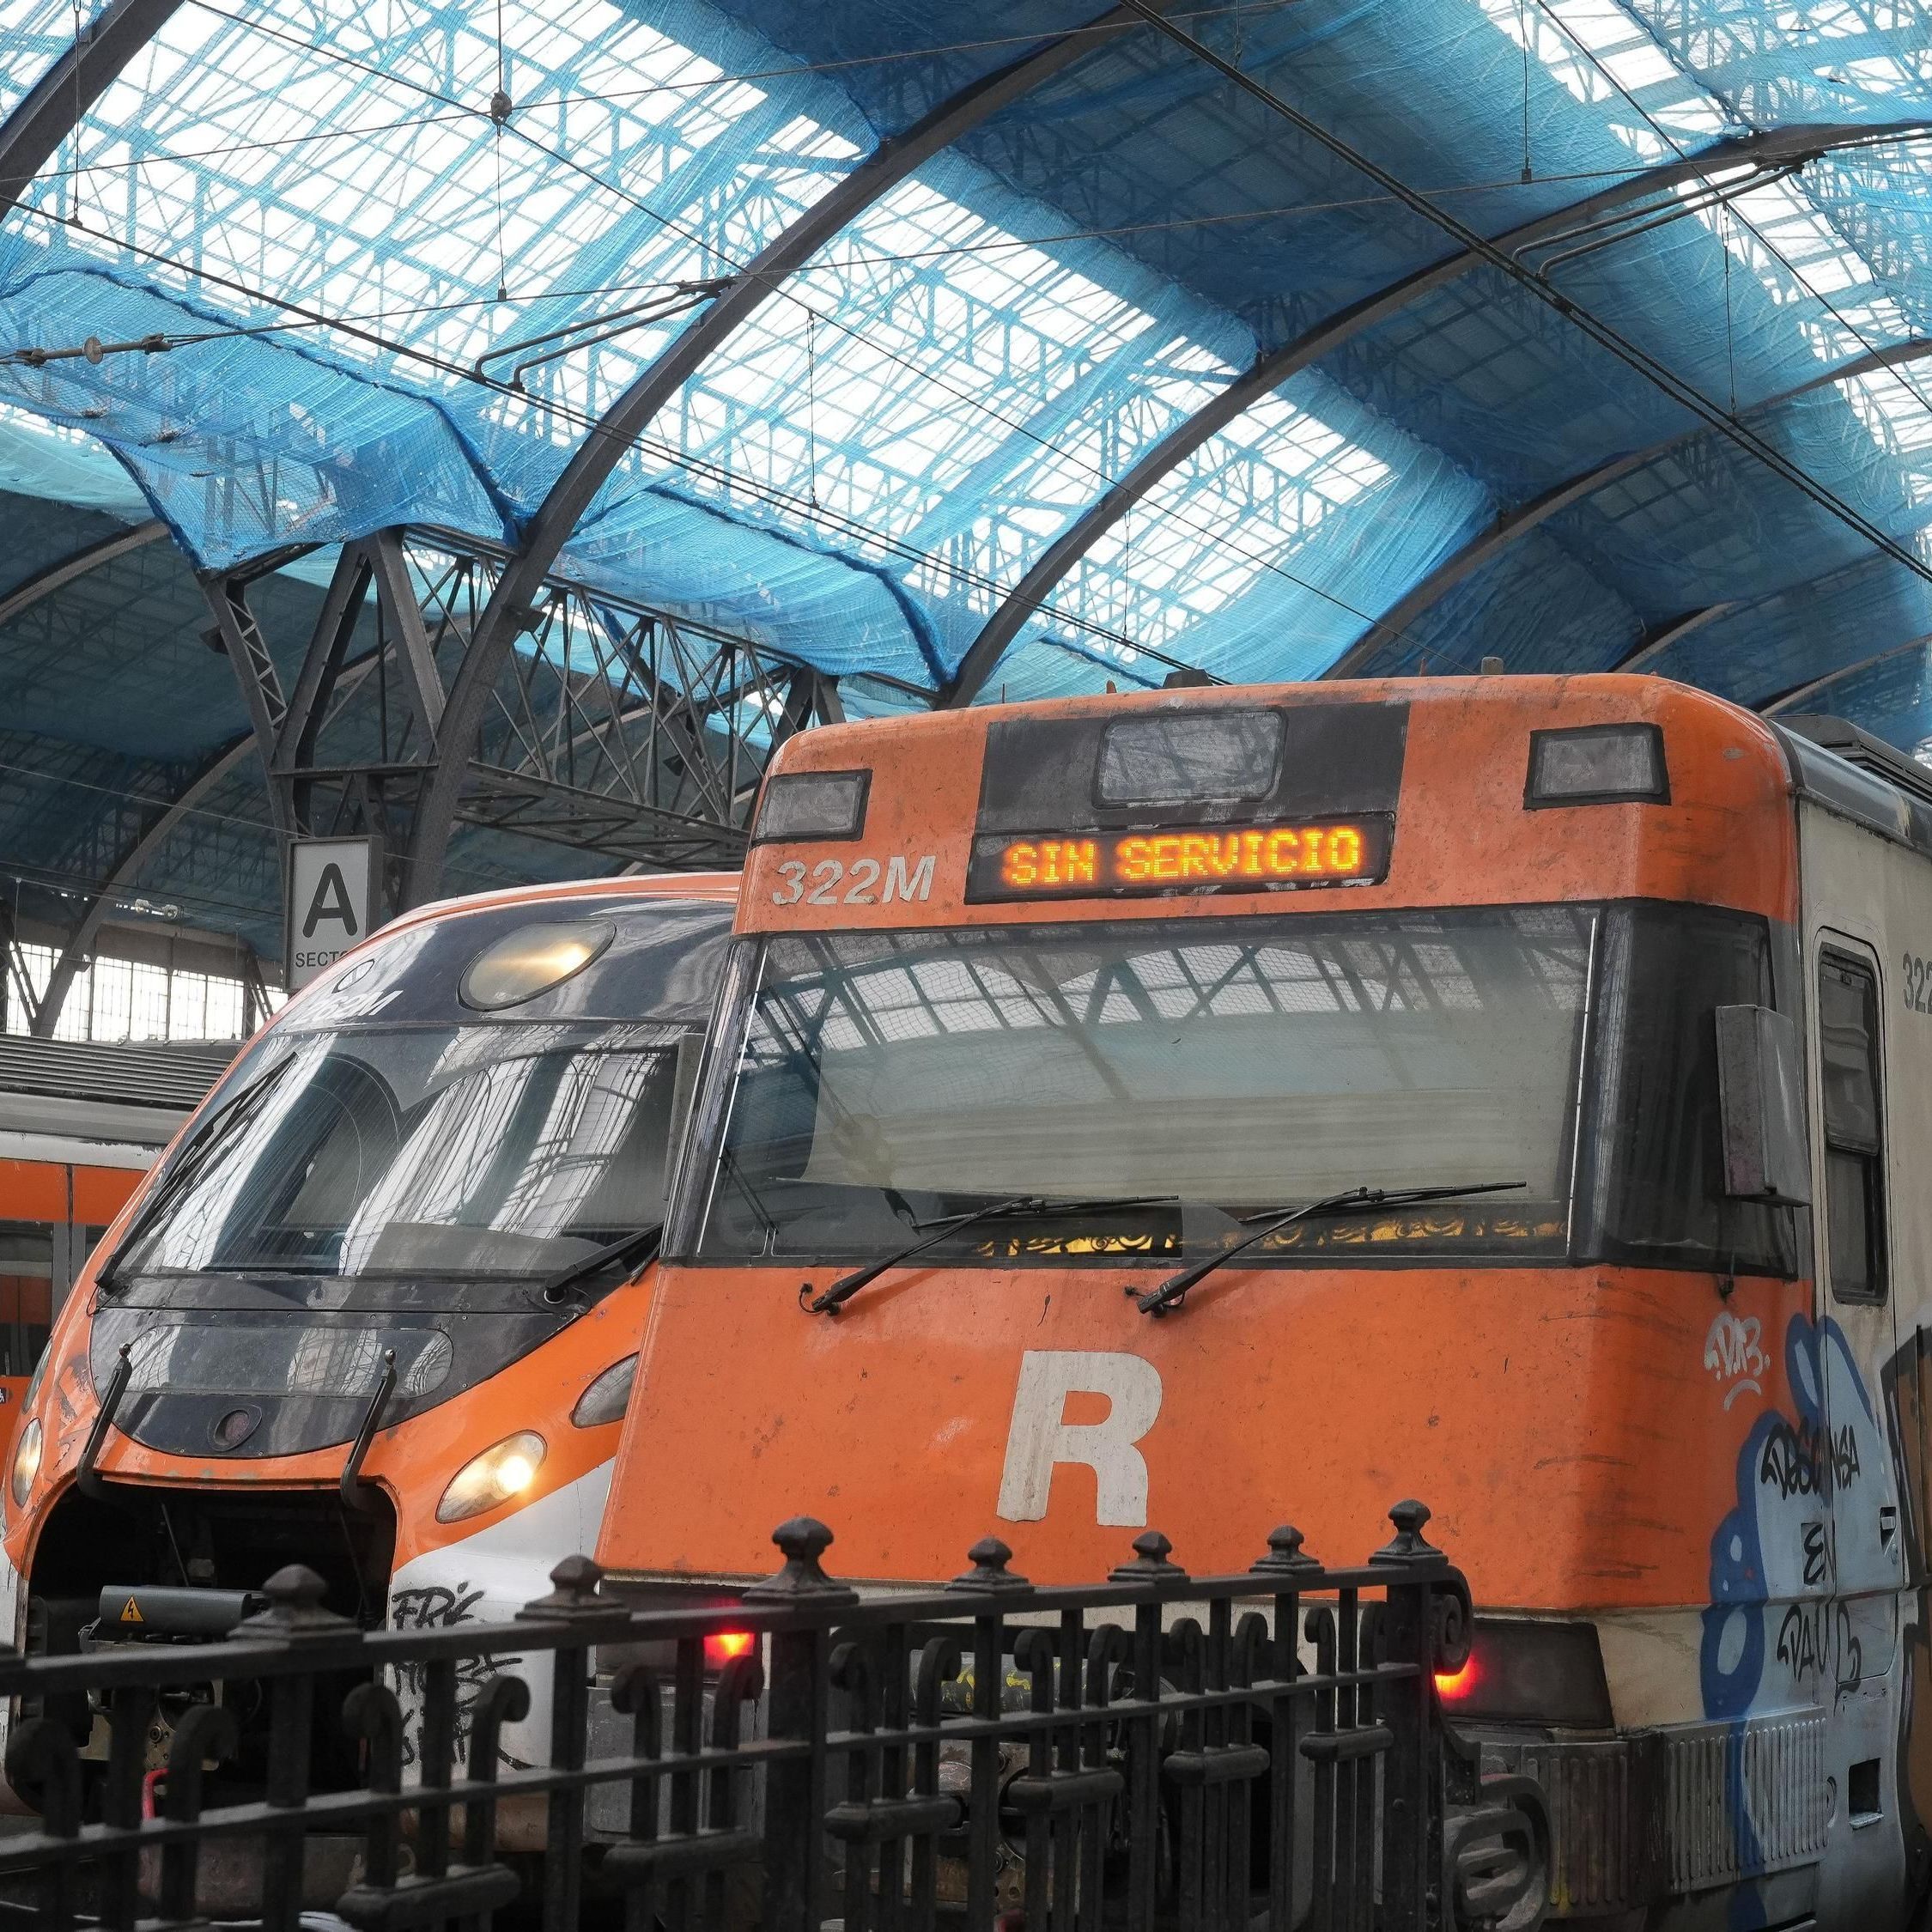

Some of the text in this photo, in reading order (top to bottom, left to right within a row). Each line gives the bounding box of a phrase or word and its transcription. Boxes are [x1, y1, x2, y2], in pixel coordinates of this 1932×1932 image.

[773, 855, 937, 906] 322M
[1011, 830, 1361, 884] SIN SERVICIO
[302, 862, 358, 939] A
[995, 1349, 1163, 1528] R
